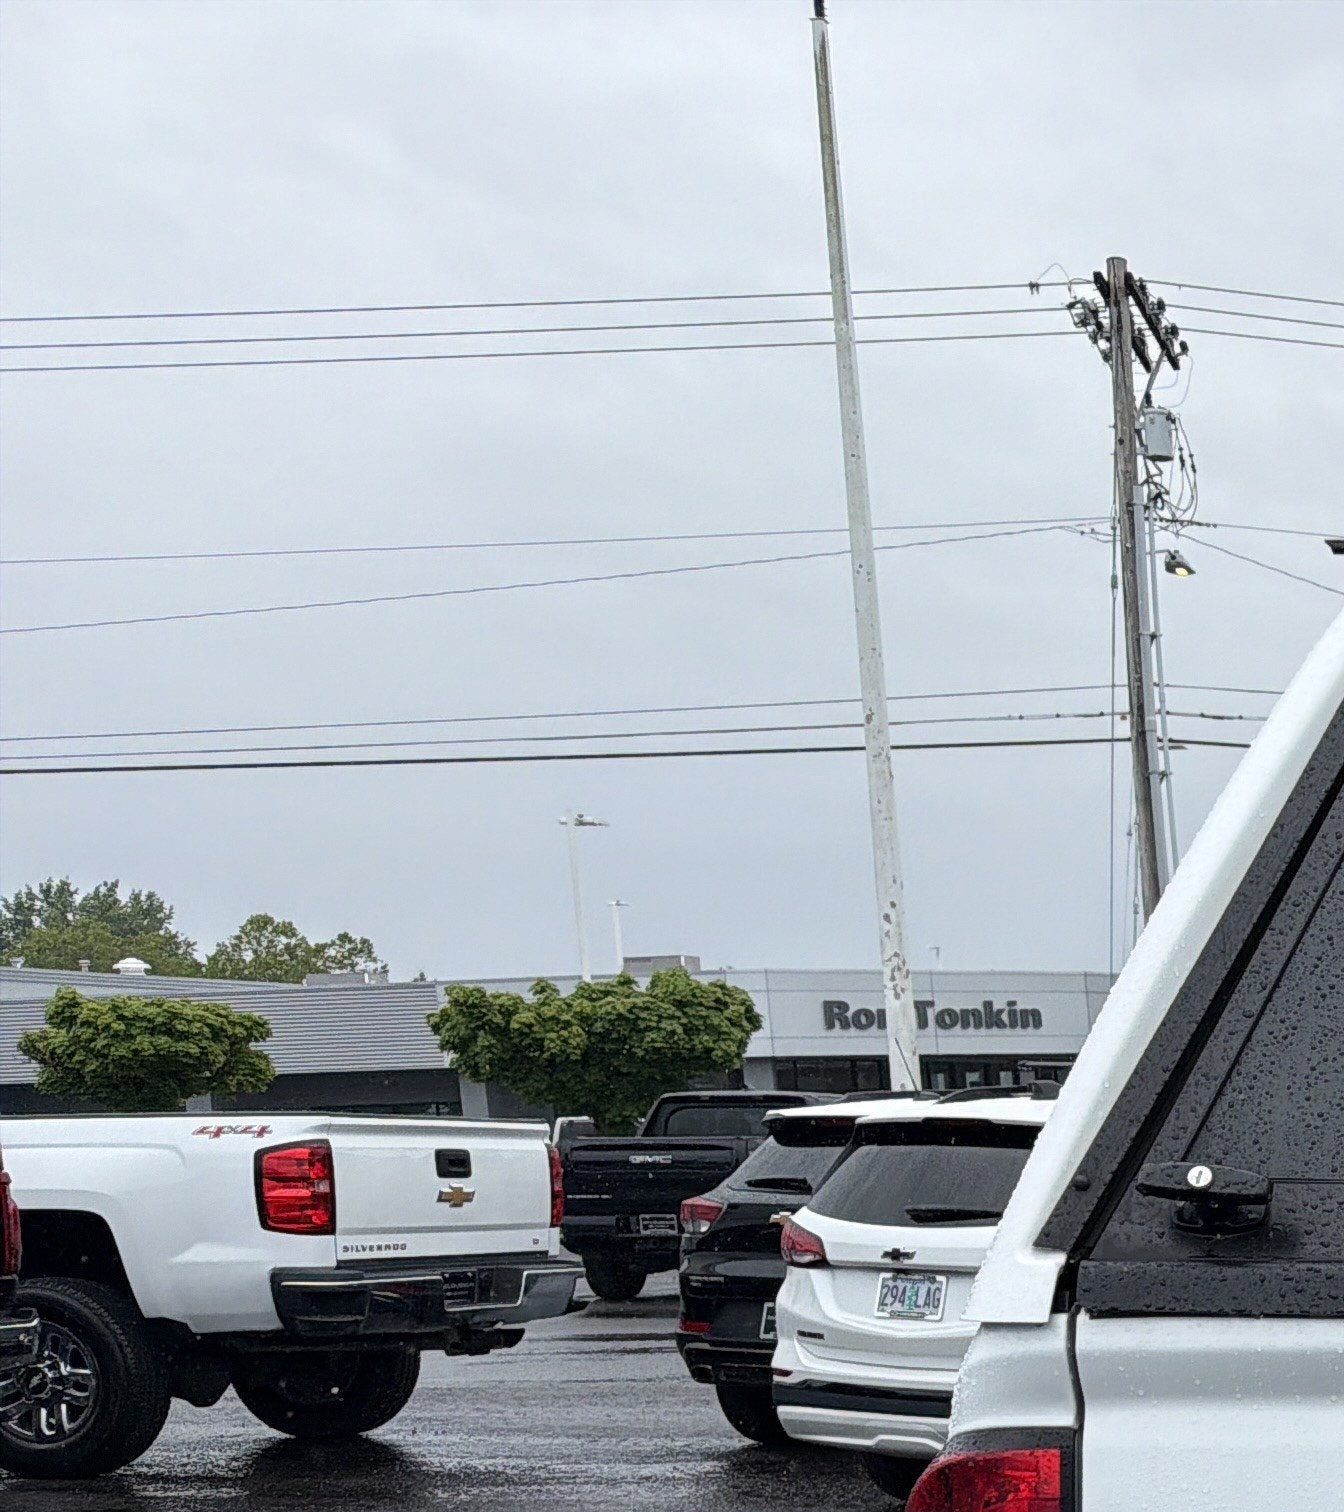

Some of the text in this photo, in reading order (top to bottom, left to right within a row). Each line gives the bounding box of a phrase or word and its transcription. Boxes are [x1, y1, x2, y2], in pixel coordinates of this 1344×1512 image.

[913, 1000, 1043, 1030] Tonkin
[342, 1242, 407, 1252] SILVERADO
[880, 1284, 942, 1309] 294 LAG
